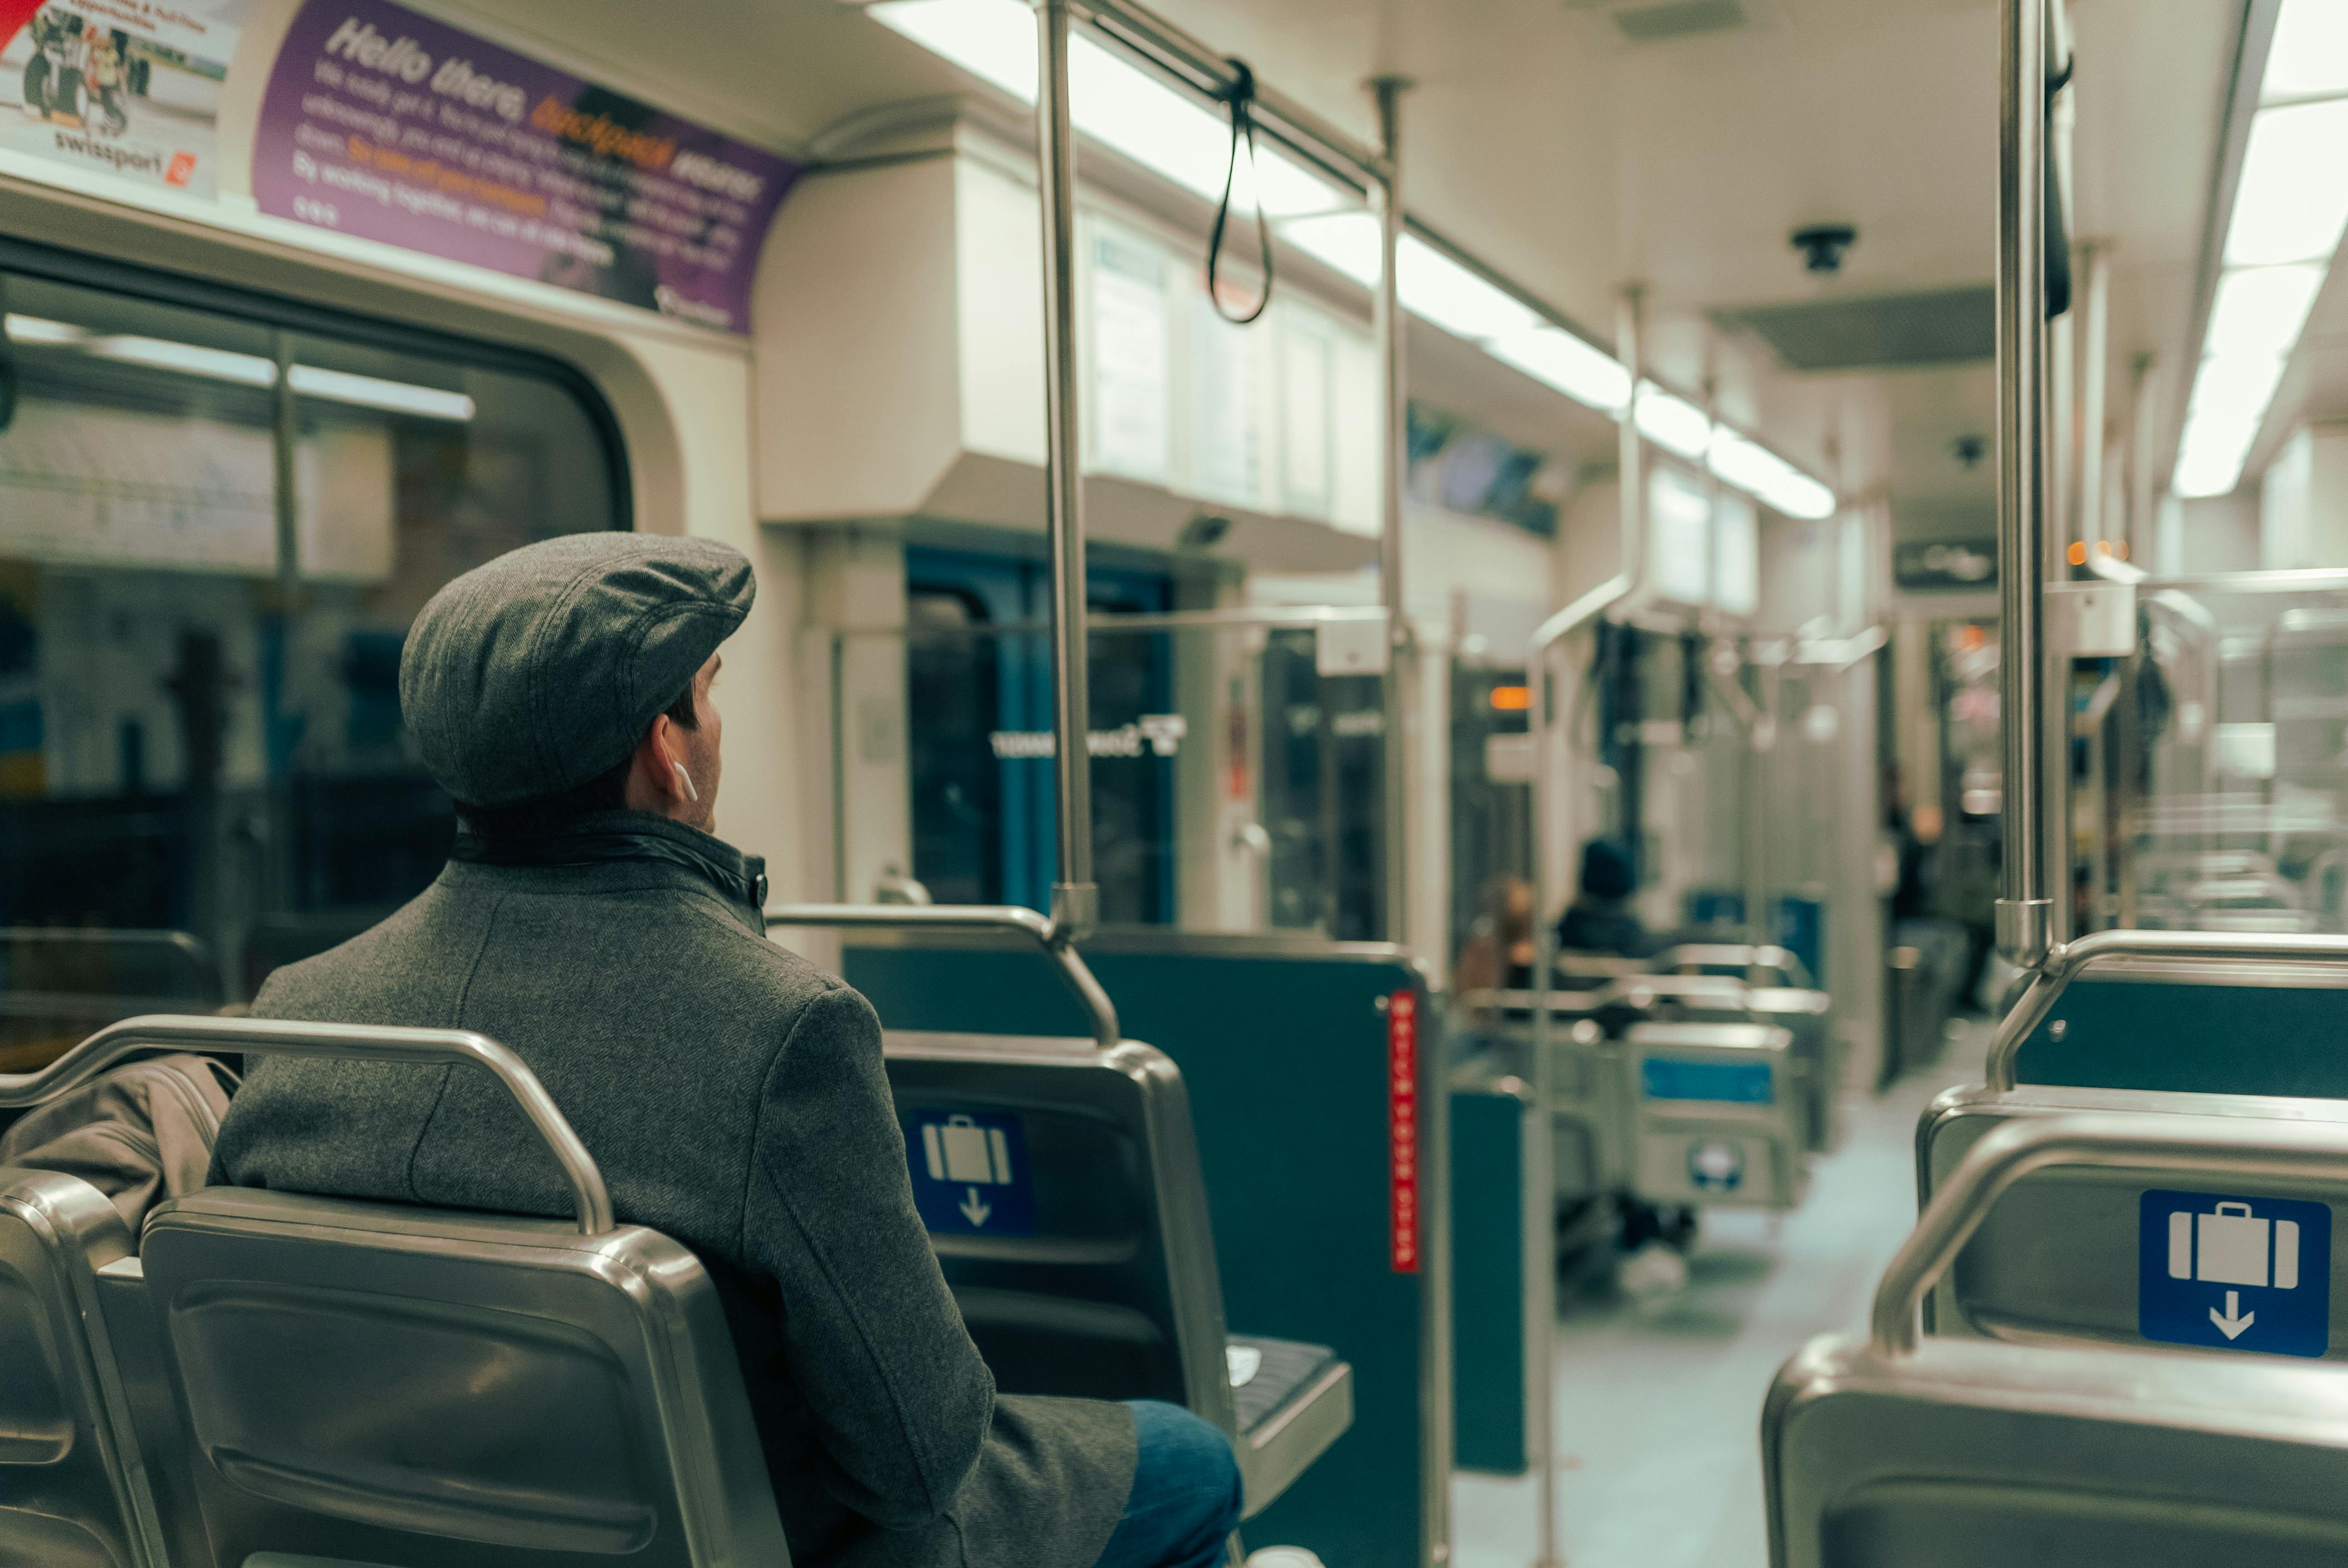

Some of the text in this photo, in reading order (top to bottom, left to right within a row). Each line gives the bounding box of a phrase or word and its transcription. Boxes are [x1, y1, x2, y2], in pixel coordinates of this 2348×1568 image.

[326, 16, 432, 84] Hello
[531, 93, 675, 168] backpack
[55, 130, 163, 175] swissport
[293, 149, 317, 184] By
[320, 166, 392, 207] working
